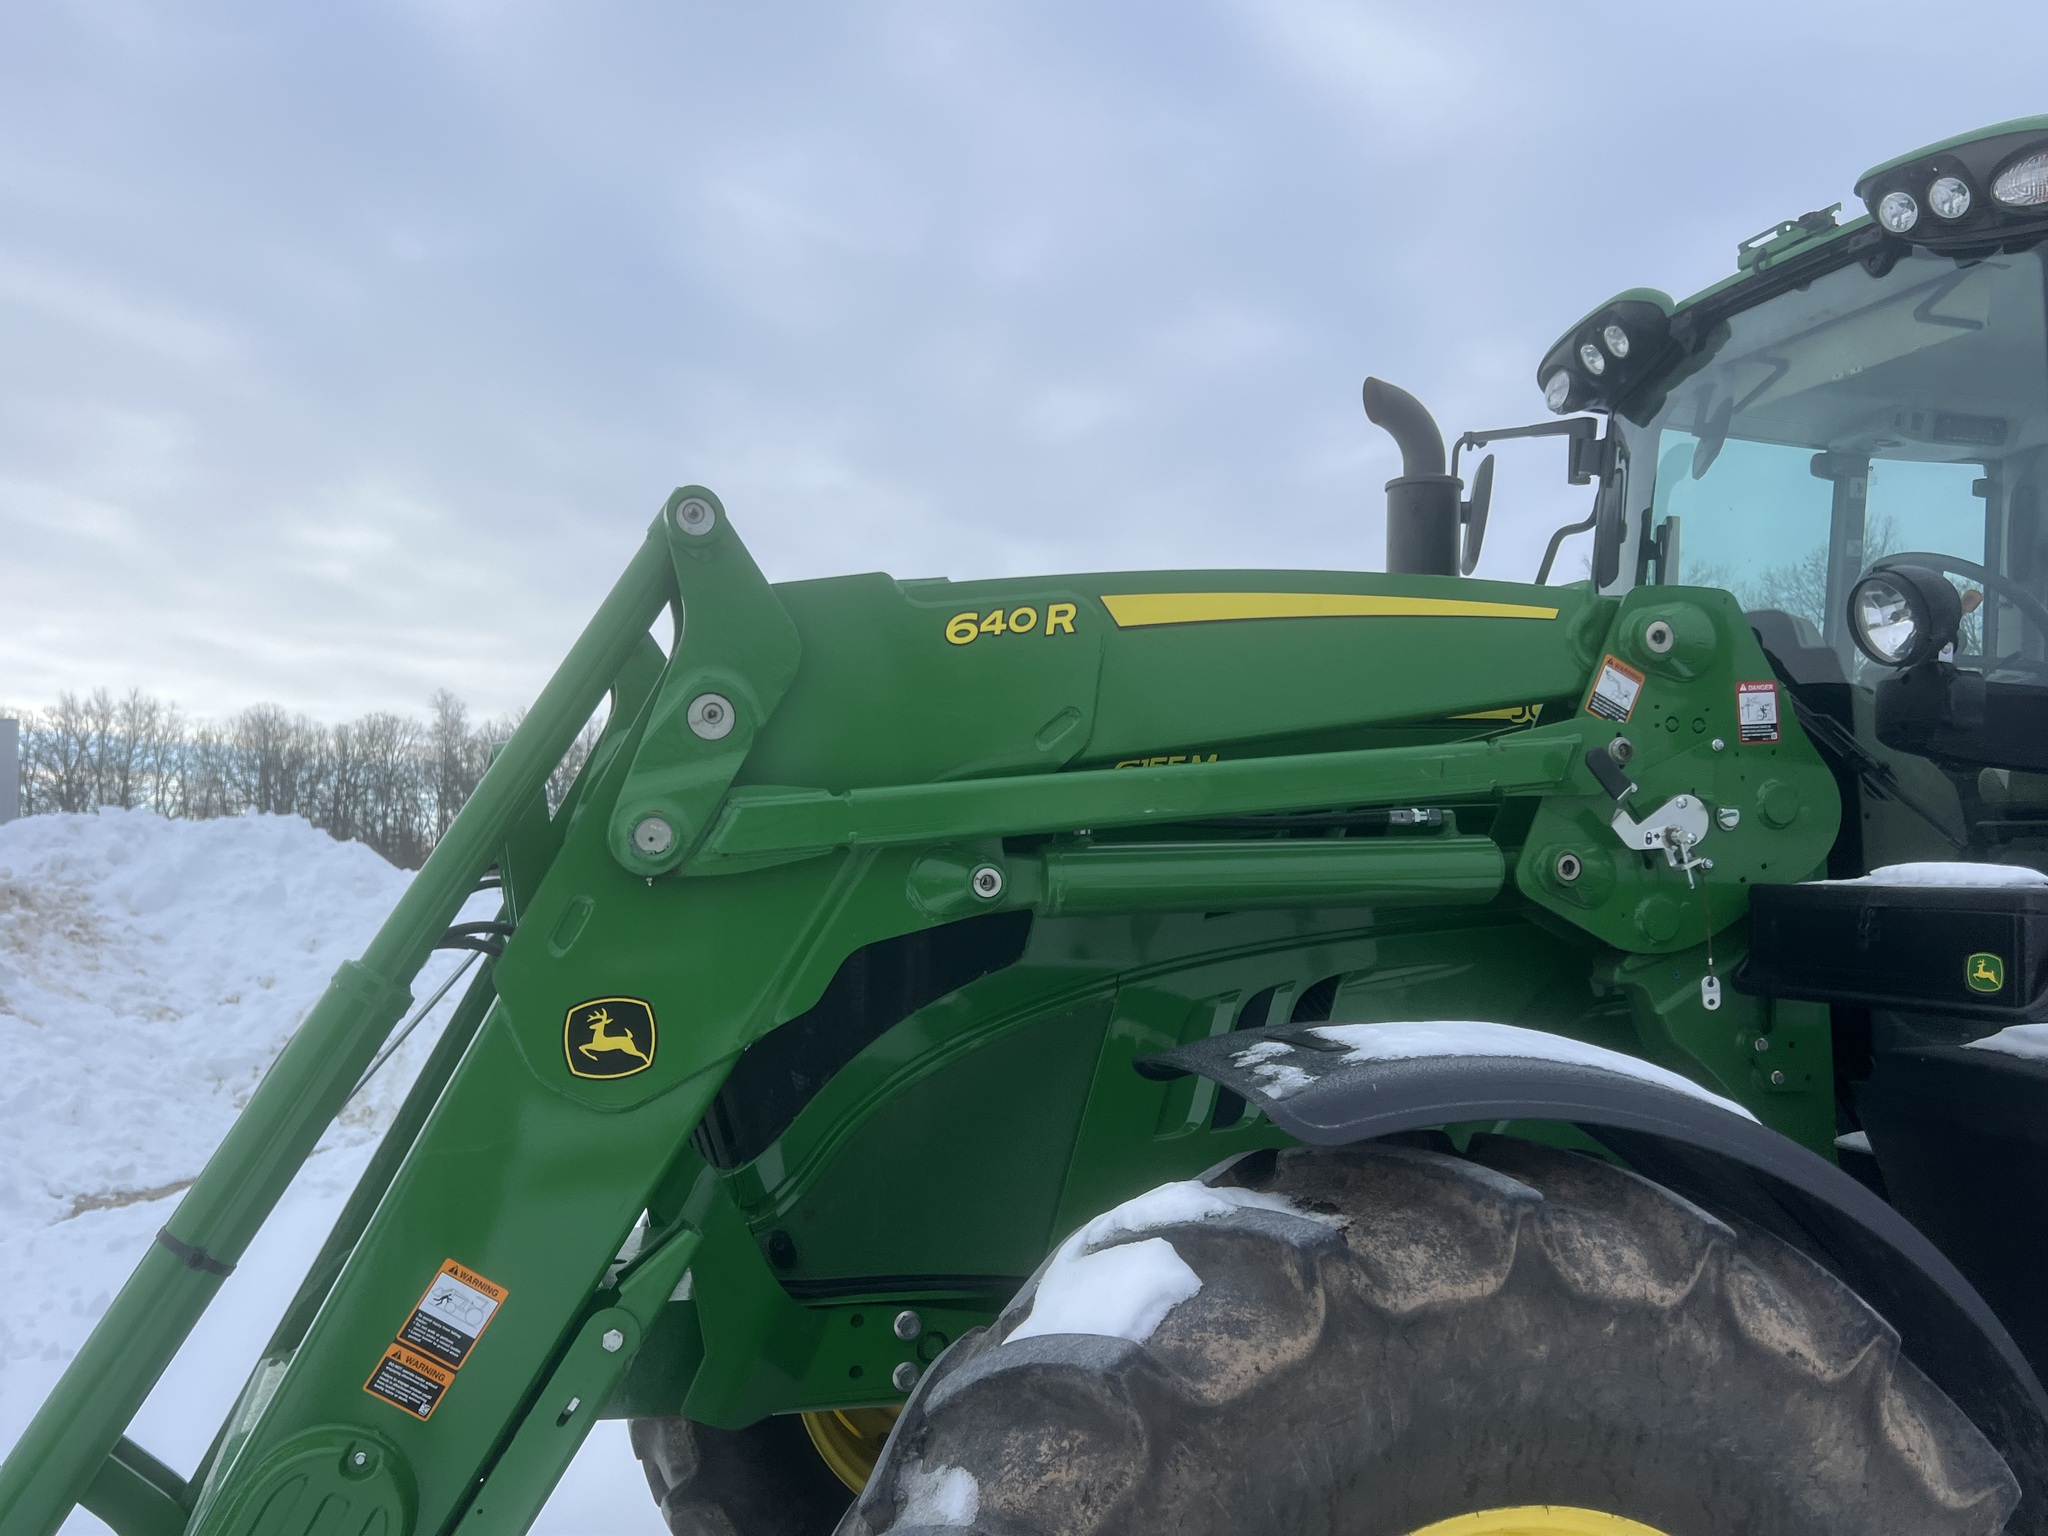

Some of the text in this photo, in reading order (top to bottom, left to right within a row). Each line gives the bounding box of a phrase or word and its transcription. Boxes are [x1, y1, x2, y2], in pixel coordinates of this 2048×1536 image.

[945, 603, 1077, 645] 640 R
[459, 1270, 499, 1297] WARNING
[405, 1355, 445, 1382] WARNING
